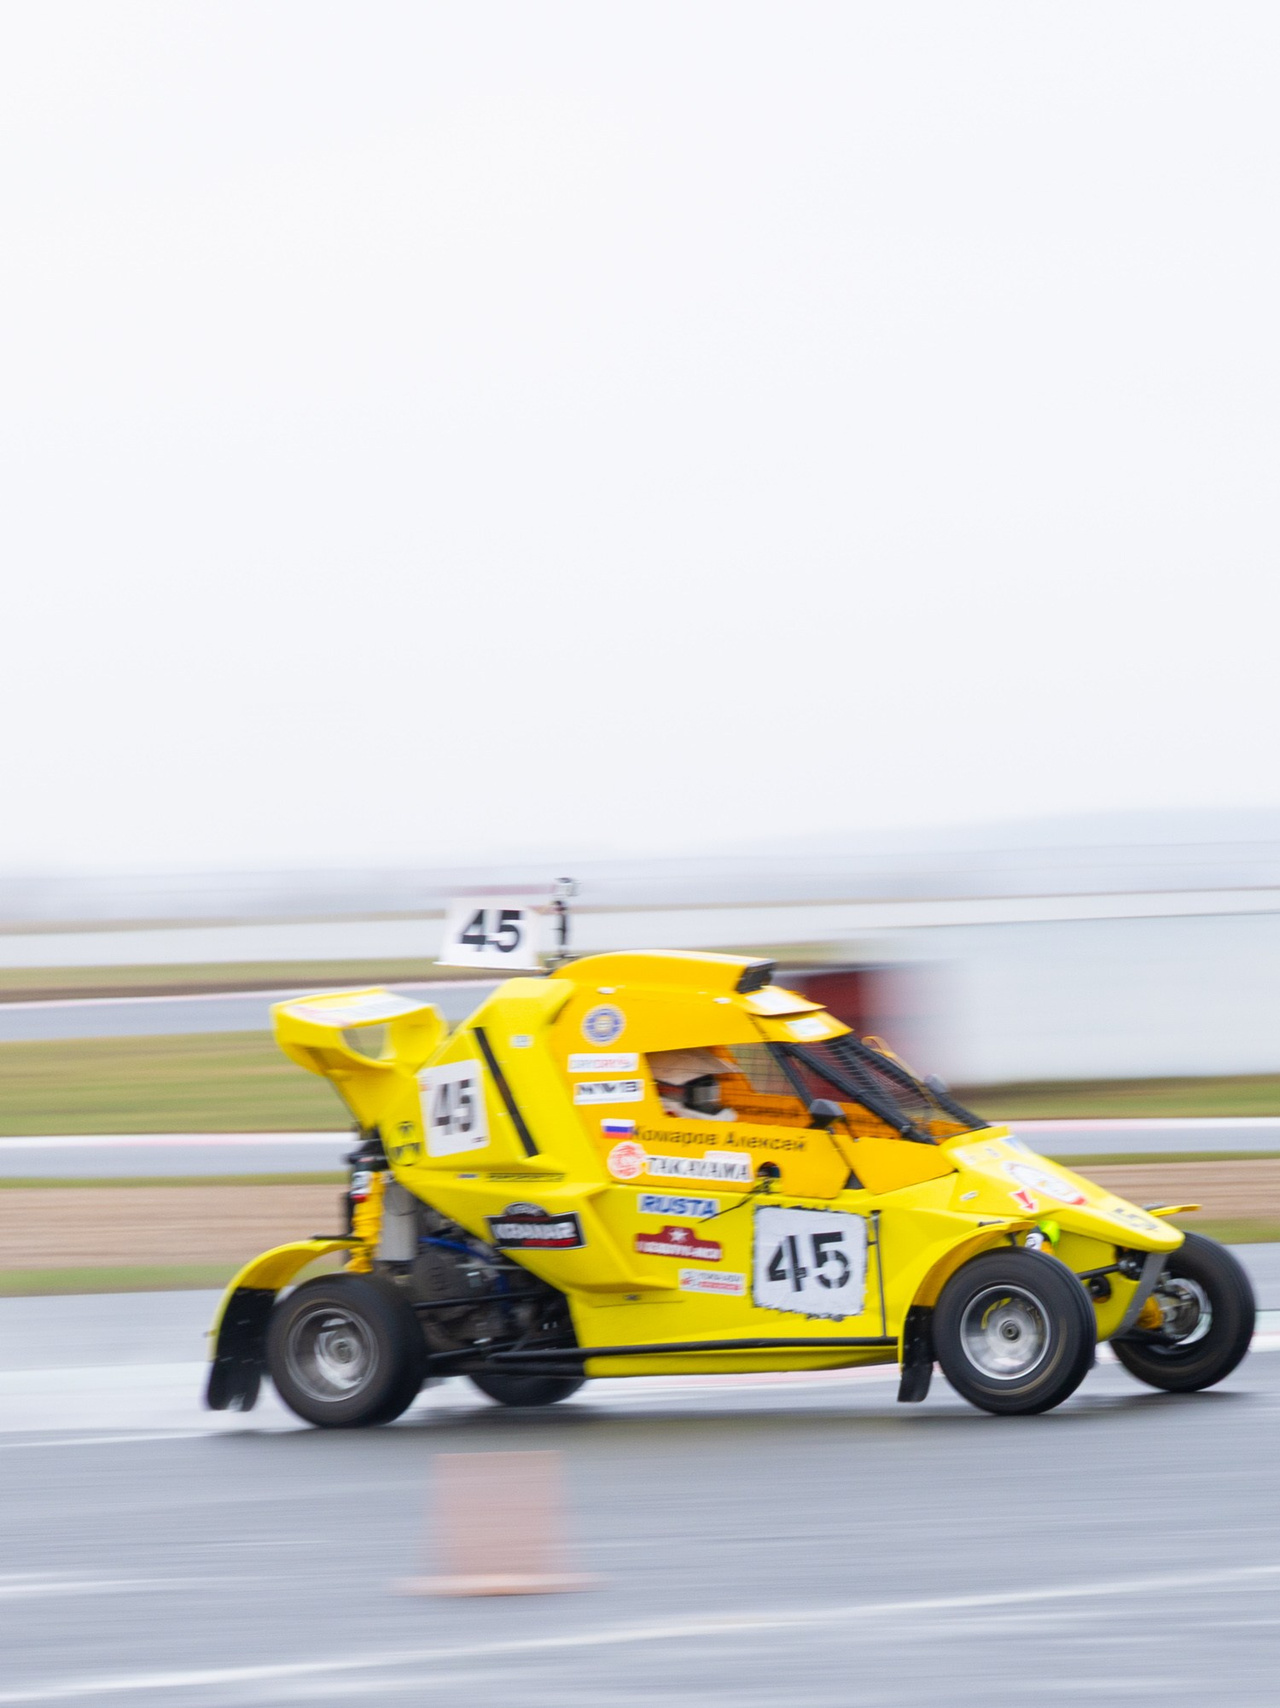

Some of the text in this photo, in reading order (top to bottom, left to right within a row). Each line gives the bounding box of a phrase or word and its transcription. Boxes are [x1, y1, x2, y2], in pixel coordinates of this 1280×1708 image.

[459, 909, 524, 952] 45
[432, 1078, 475, 1136] 45
[632, 1126, 808, 1151] Комаров Алексей
[647, 1157, 751, 1181] TAKAYAMA
[641, 1195, 715, 1216] RUSTA
[767, 1231, 851, 1293] 45
